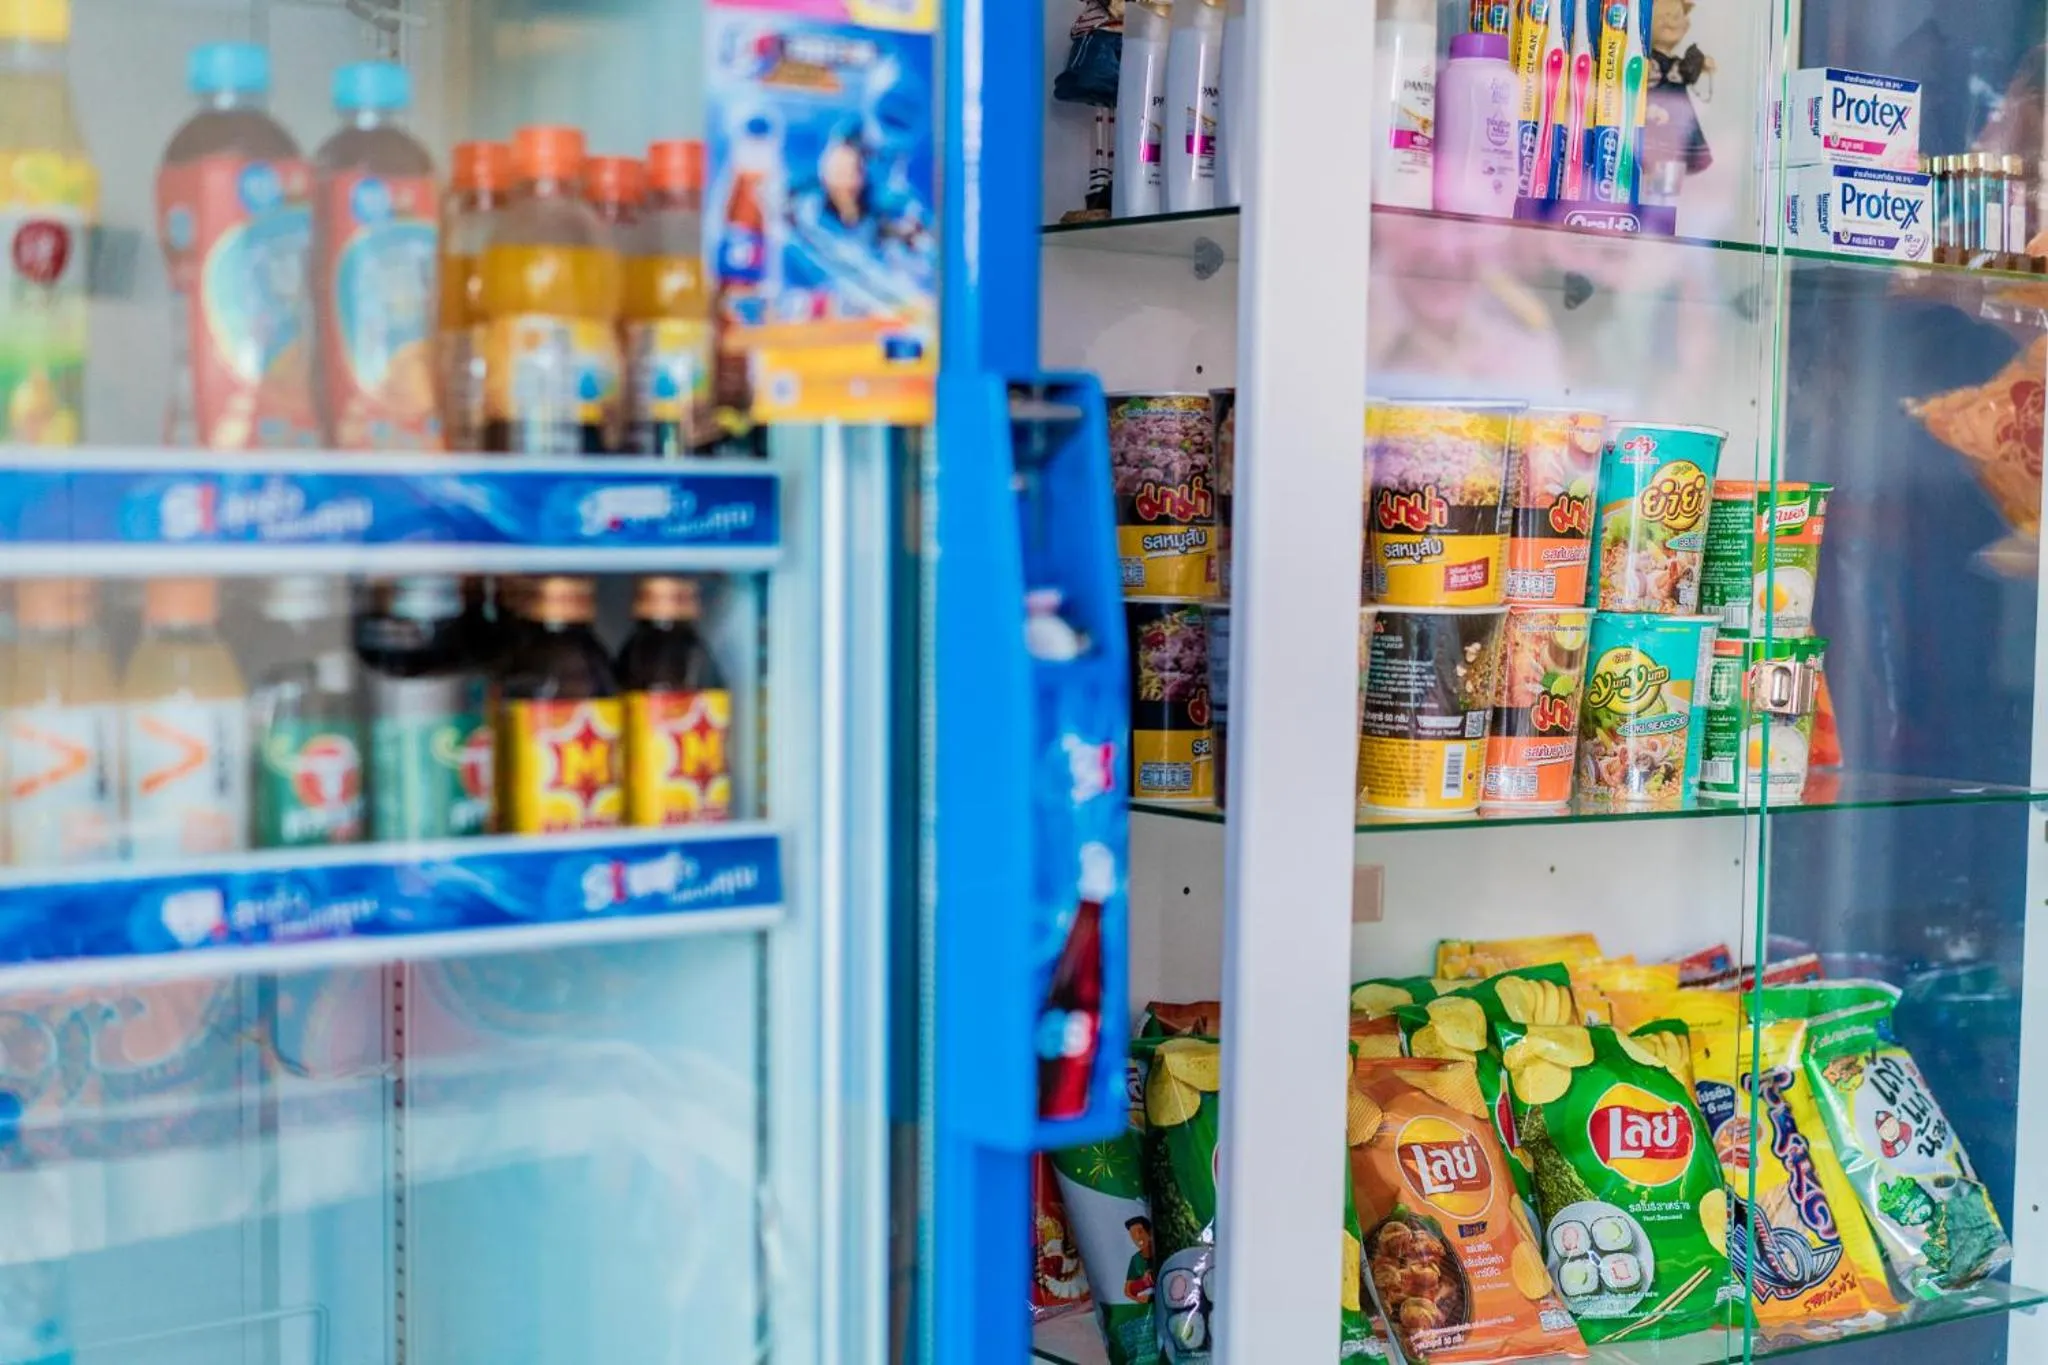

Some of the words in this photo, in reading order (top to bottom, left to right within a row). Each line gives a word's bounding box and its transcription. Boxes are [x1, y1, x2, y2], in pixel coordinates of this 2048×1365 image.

[1527, 34, 1538, 73] CLEAN
[1606, 41, 1617, 79] CLEAN
[1833, 87, 1912, 135] Protex
[1841, 183, 1924, 230] Protex
[1136, 476, 1212, 522] มาม่า
[1379, 486, 1448, 532] มาม่า
[1143, 527, 1207, 554] รสหมูสับ
[1383, 537, 1443, 562] รสหมูสับ
[1587, 670, 1632, 709] Yum
[1618, 661, 1668, 700] Yum
[1647, 714, 1689, 731] SEAFOOD
[1707, 1102, 1717, 1114] 6
[1609, 1106, 1679, 1160] เลย์
[1411, 1133, 1478, 1195] เลย์
